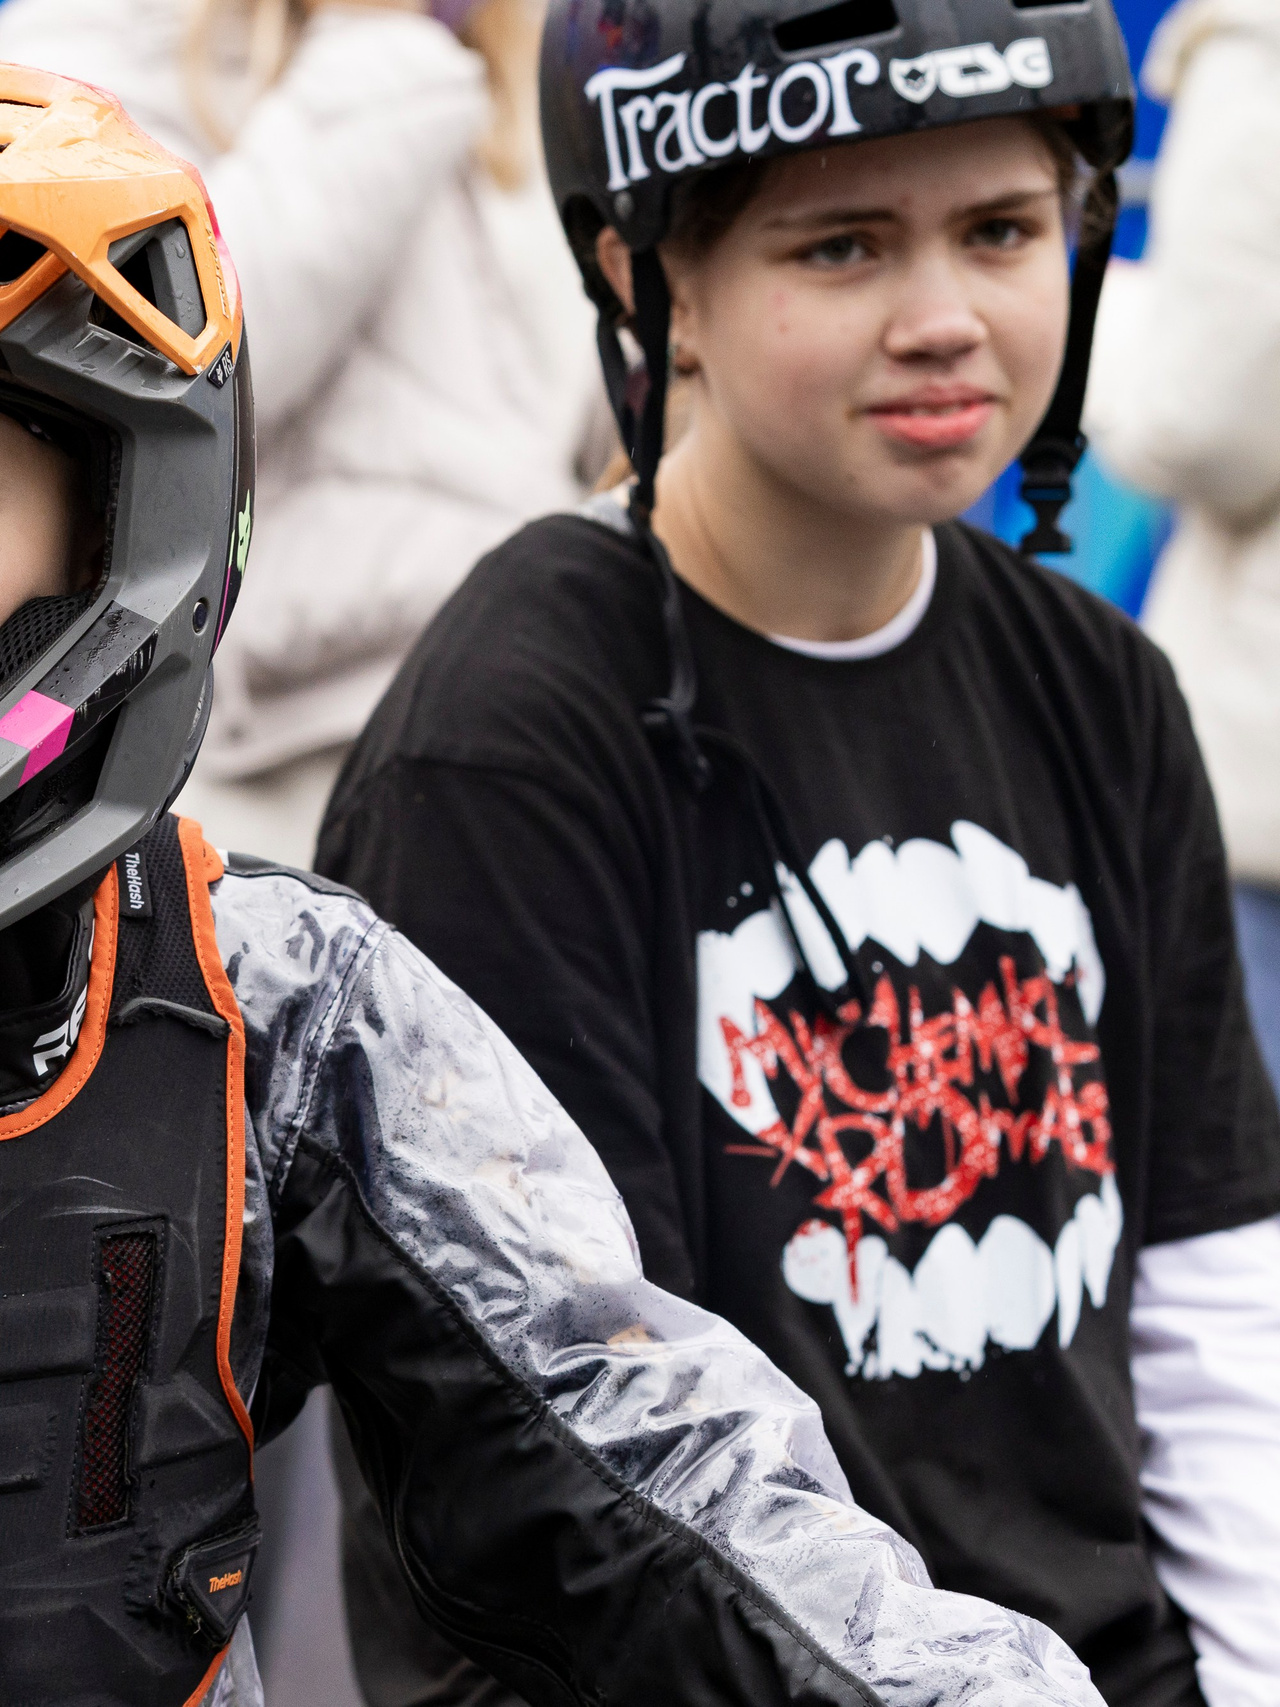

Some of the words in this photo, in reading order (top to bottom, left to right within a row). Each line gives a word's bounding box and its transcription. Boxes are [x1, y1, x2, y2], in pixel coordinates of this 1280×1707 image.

[585, 48, 880, 192] Tractor
[125, 852, 145, 909] TheHash
[209, 1569, 243, 1593] TheHash
